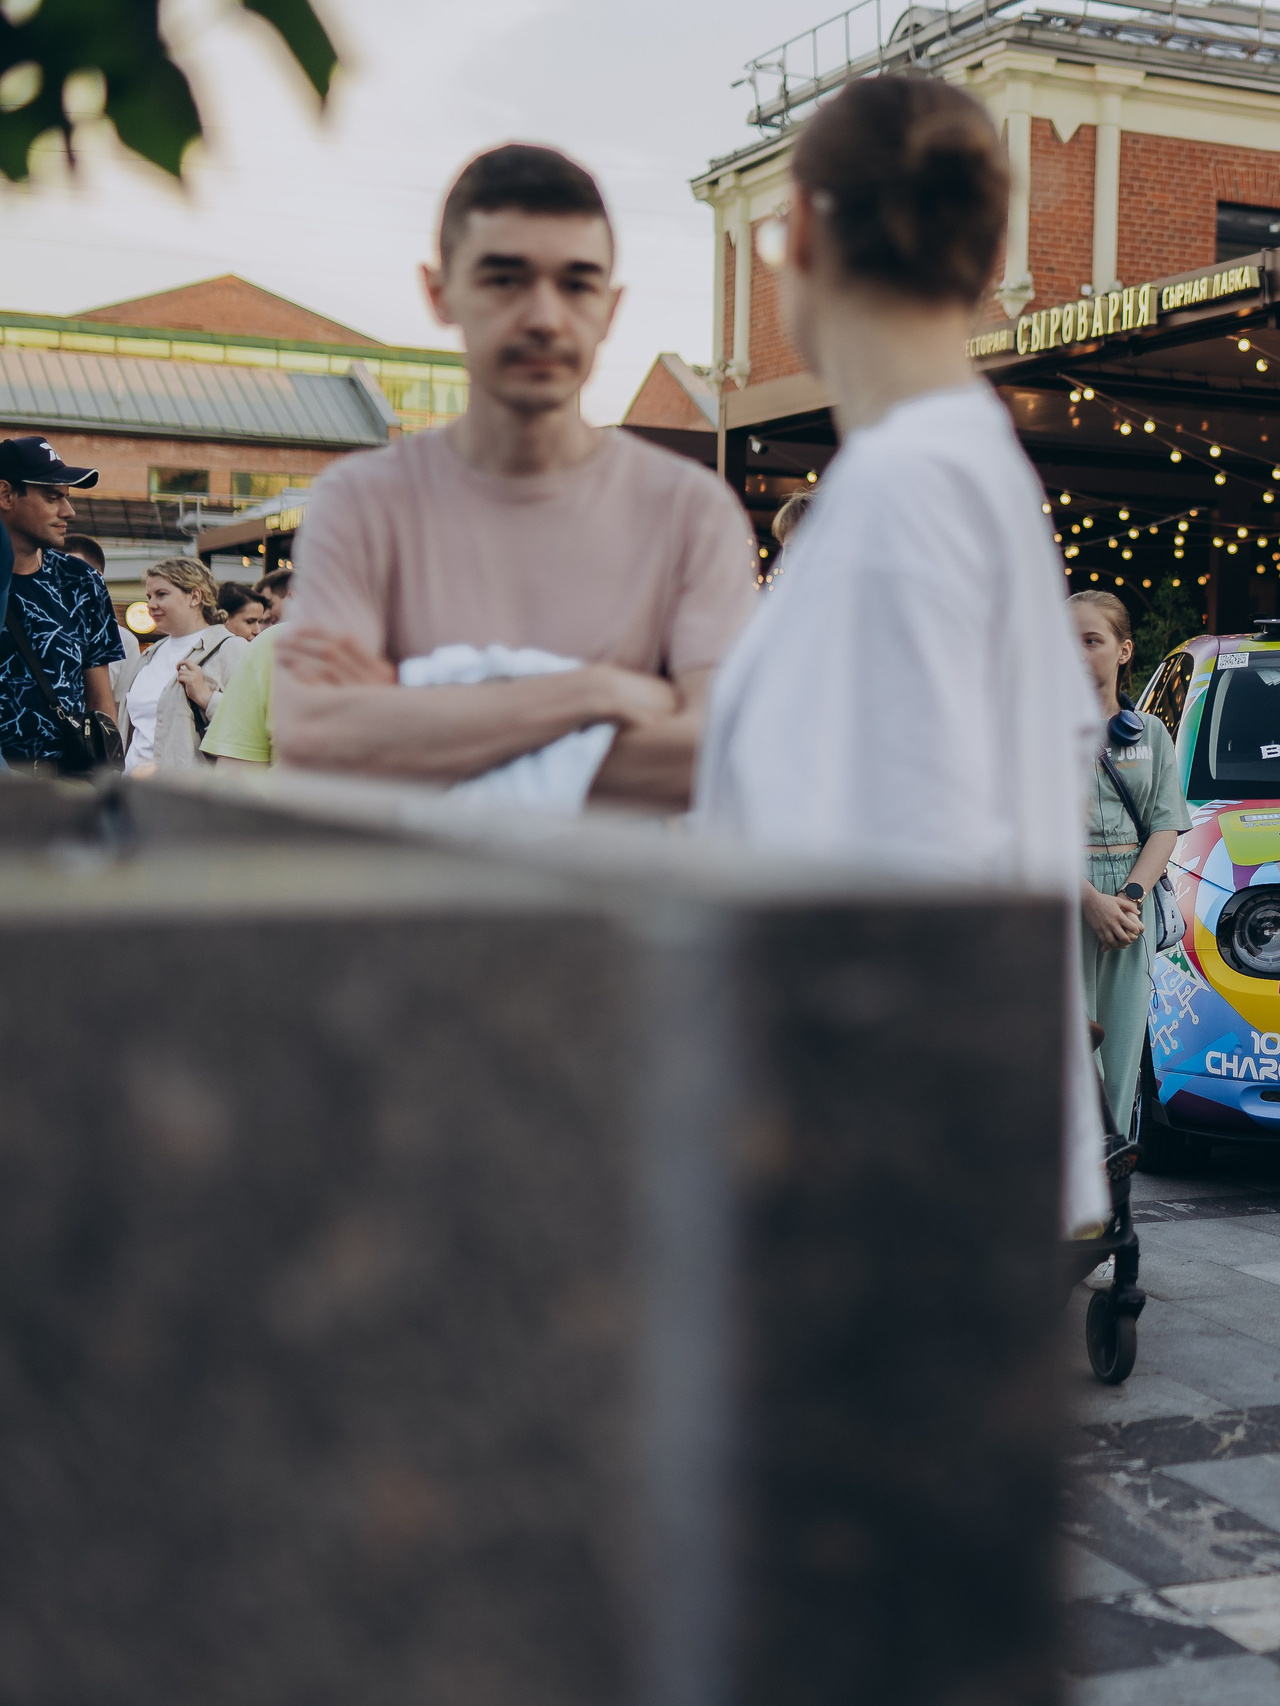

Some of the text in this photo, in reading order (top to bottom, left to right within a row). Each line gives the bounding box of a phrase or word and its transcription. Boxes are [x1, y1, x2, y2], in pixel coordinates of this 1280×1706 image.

[963, 265, 1251, 358] ЕСТОРАН СЫРОВАРНЯ СЫРНАЯ ЛАВКА
